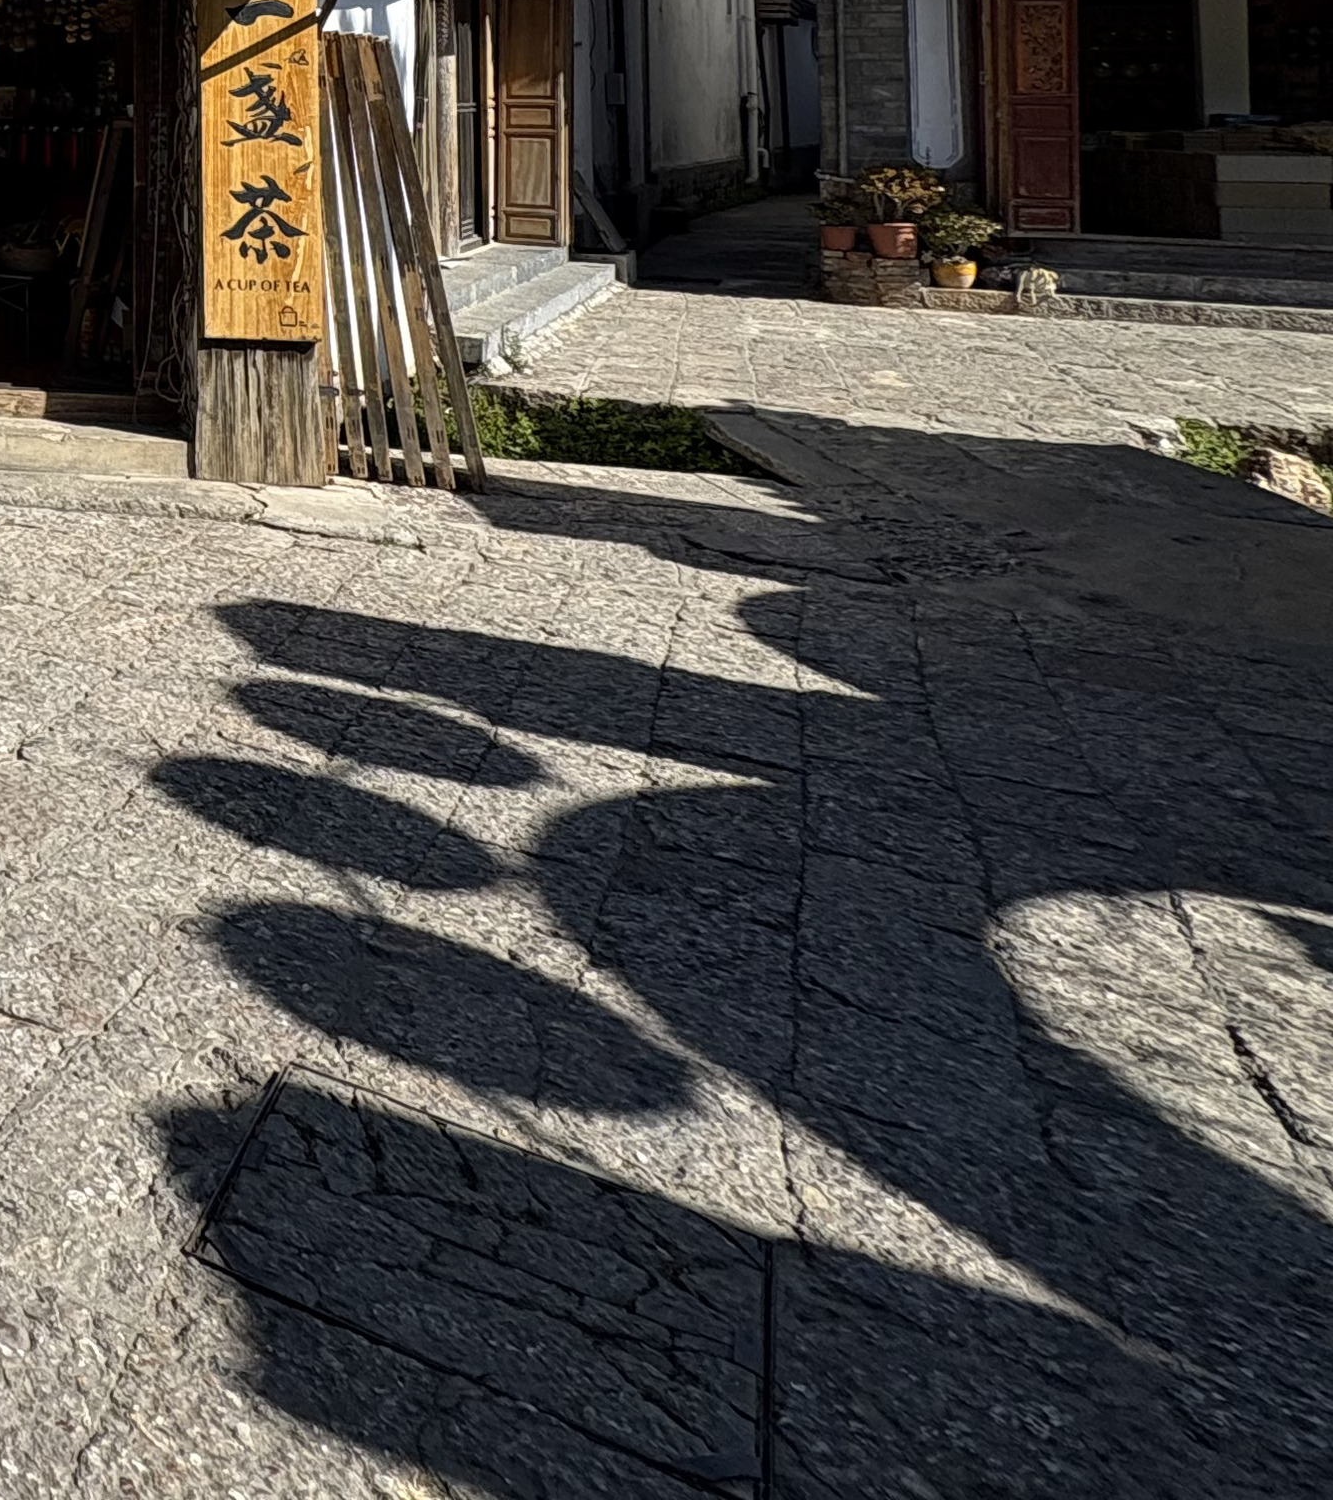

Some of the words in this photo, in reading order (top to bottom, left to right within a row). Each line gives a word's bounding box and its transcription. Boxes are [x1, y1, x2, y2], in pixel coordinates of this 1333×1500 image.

[220, 0, 309, 264] 一盏茶
[214, 278, 224, 291] A
[227, 279, 257, 291] CUP
[261, 280, 280, 292] OF
[285, 280, 311, 293] TEA
